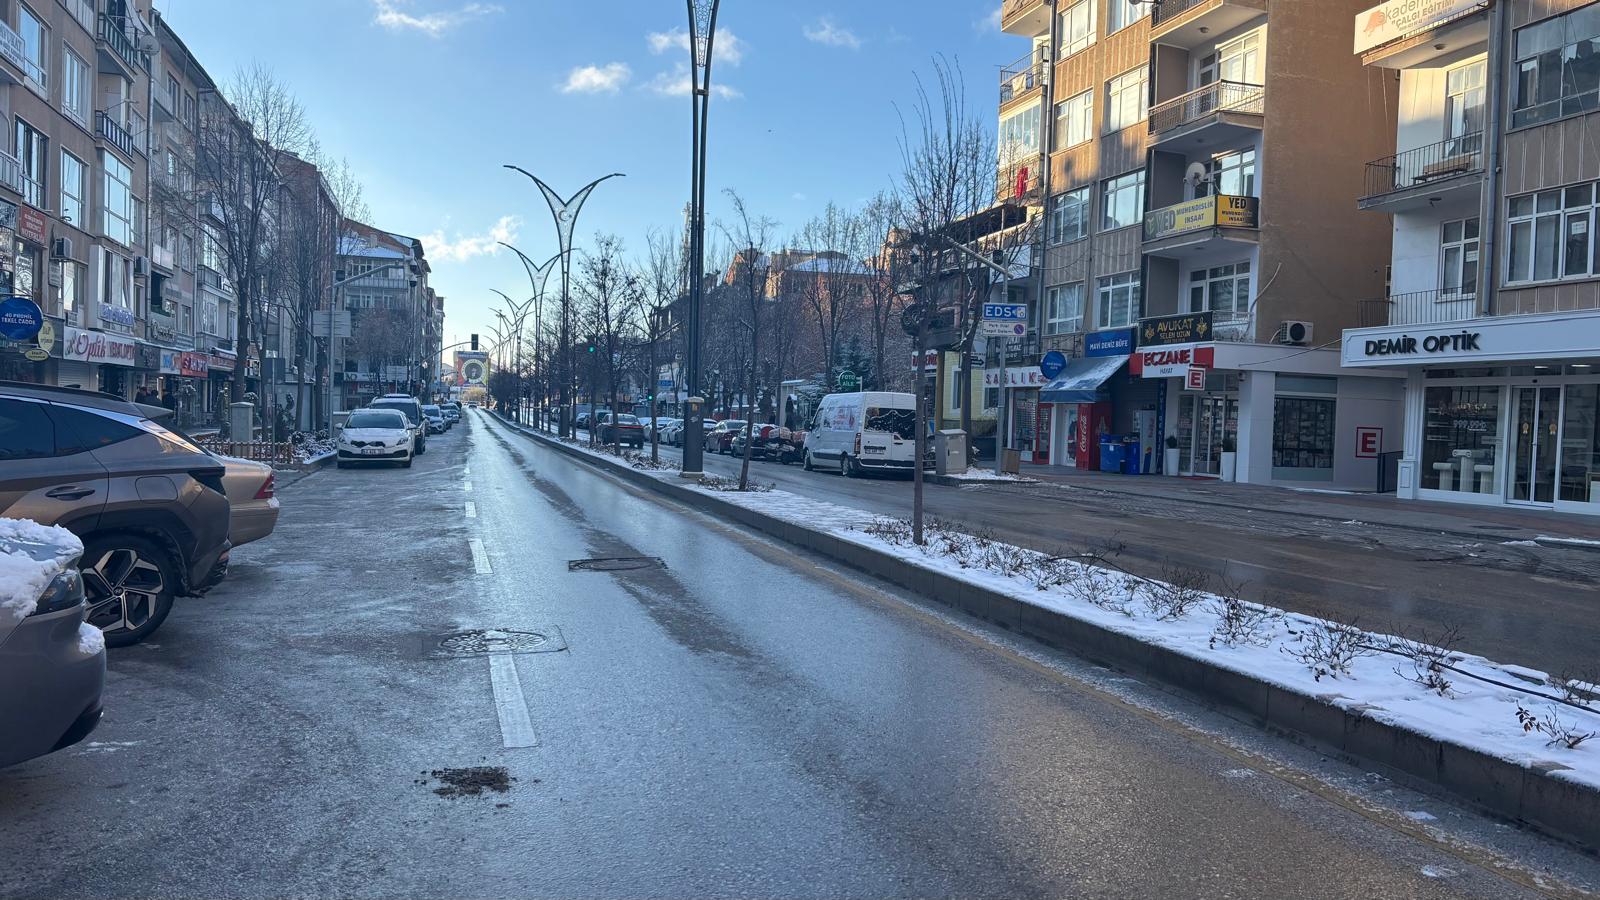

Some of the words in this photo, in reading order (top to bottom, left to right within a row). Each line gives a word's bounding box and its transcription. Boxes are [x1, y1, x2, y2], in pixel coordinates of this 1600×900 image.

[1229, 197, 1247, 209] YED
[1157, 209, 1175, 232] YED
[985, 306, 1012, 317] EDS
[1157, 318, 1194, 333] AVUKAT
[1101, 340, 1115, 349] DENİZ
[1365, 334, 1418, 356] DEMİR
[1423, 330, 1480, 352] OPTİK
[1144, 349, 1190, 367] ECZANE
[1190, 372, 1201, 387] E
[1362, 433, 1376, 452] E
